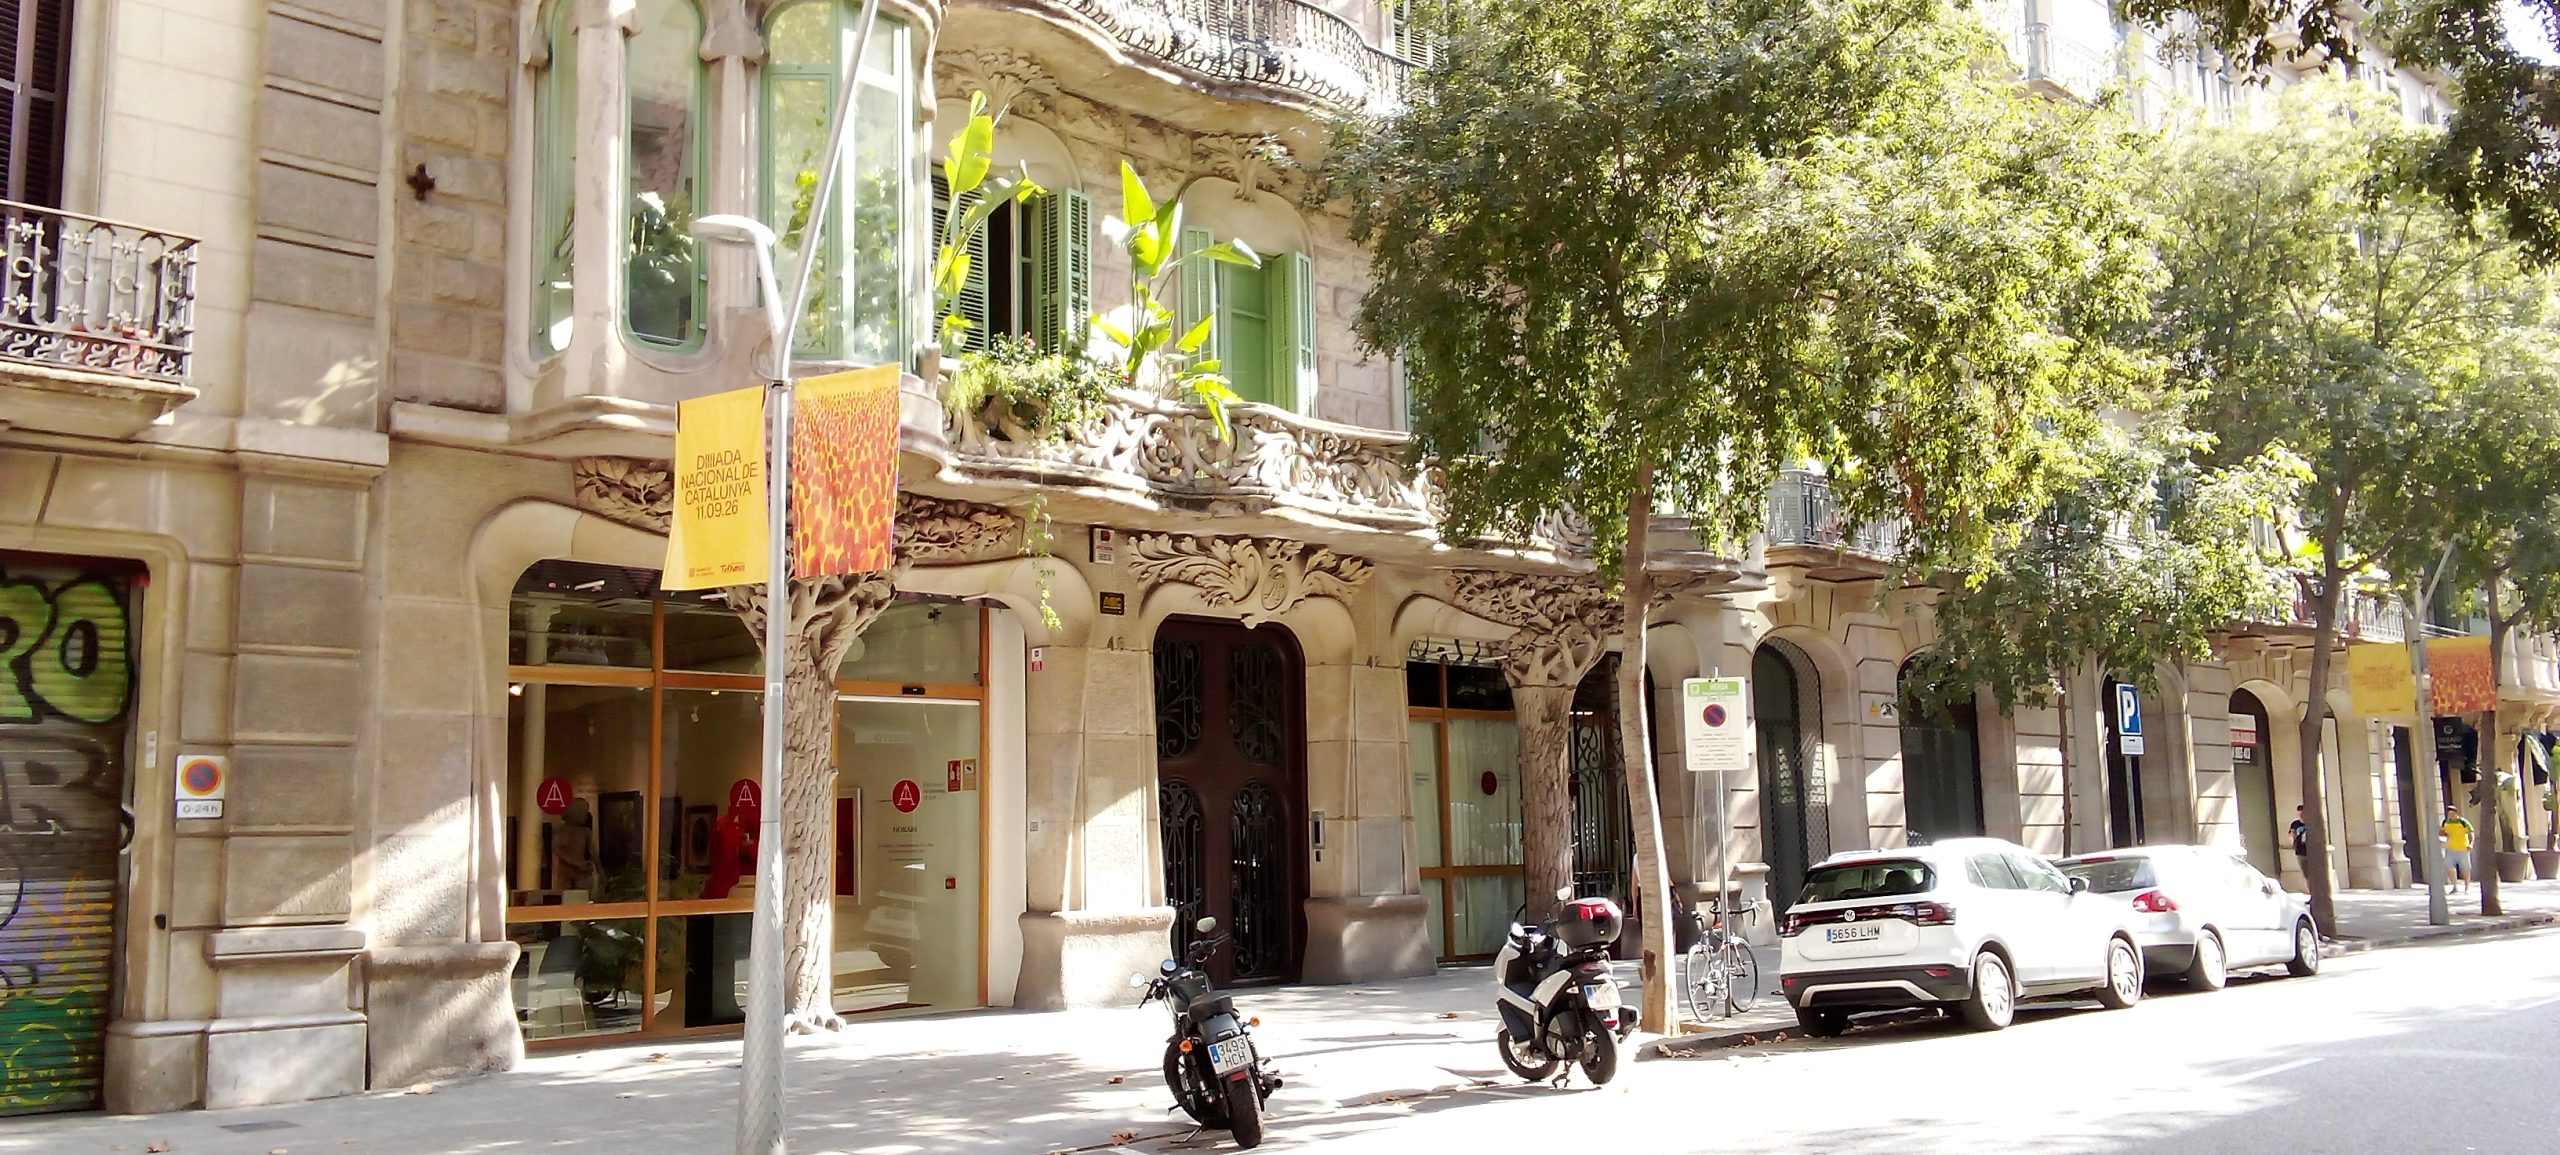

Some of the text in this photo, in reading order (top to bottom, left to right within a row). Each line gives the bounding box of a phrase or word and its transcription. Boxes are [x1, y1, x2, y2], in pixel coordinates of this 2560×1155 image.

[681, 461, 758, 490] NACIONAL DE
[685, 481, 752, 506] CATALUNYA
[696, 499, 738, 520] 11.09.26
[2122, 690, 2135, 729] P
[1831, 927, 1858, 940] 5656
[1217, 1037, 1246, 1057] 3493
[1224, 1050, 1247, 1068] HCH
